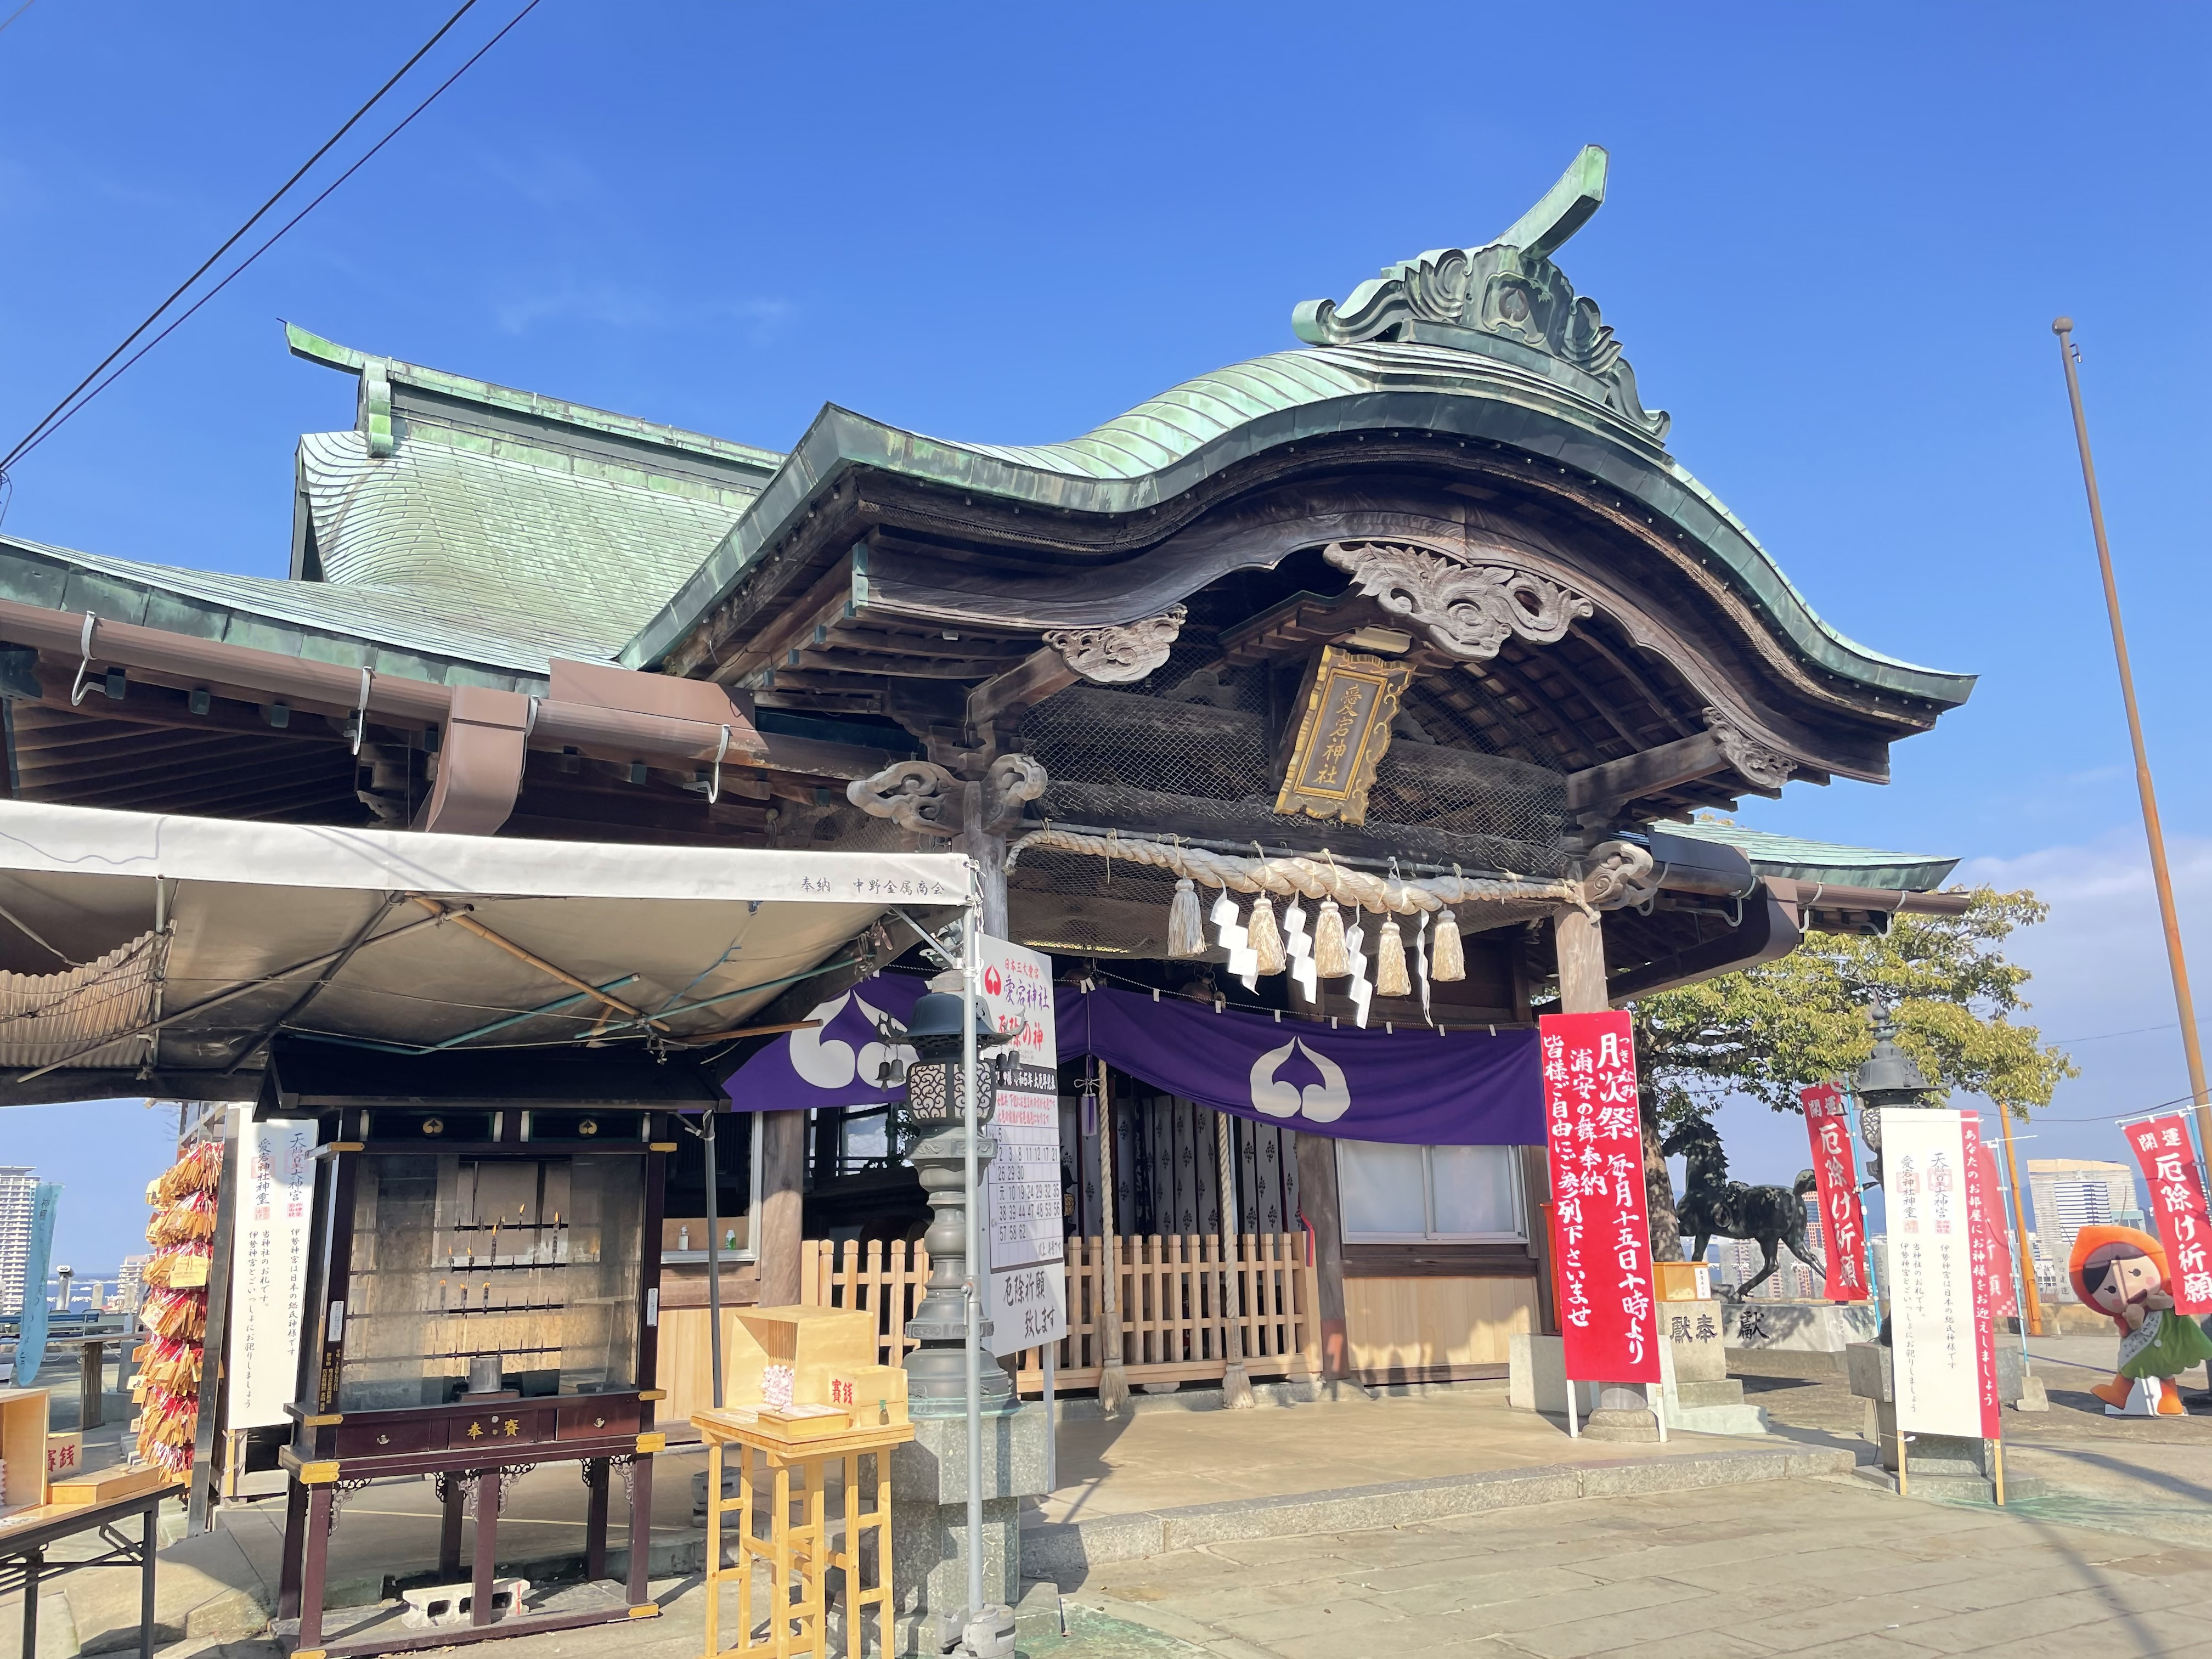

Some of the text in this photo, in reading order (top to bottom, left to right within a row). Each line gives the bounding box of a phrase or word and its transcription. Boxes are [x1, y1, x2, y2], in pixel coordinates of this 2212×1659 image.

[1312, 684, 1363, 785] 愛宕神社
[800, 876, 945, 896] 奉納 中野金属商会
[1003, 974, 1050, 1011] 愛宕神社
[1808, 1095, 1838, 1119] 開運
[998, 1127, 1002, 1142] 5
[1570, 1048, 1608, 1196] 浦安の舞奉納
[2137, 1127, 2182, 1152] 開運
[999, 1147, 1058, 1161] 2 3 8 11 12 17 21
[997, 1165, 1024, 1181] 26 29 30
[1000, 1183, 1060, 1200] 元 10 19 24 29 32 35
[1596, 1032, 1649, 1364] 月次祭 毎月十五日十時より
[1819, 1122, 1859, 1288] 厄除け祈願
[999, 1201, 1060, 1221] 38 39 44 47 48 53 56
[1000, 1224, 1026, 1242] 57 58 62
[2154, 1152, 2212, 1304] 厄除け祈願
[1965, 1129, 1993, 1406] あなたのお部屋にお神様をお迎えしましょう
[1003, 1271, 1045, 1306] 厄除祈願
[1024, 1305, 1055, 1339] 致します
[832, 1378, 853, 1406] 賽銭
